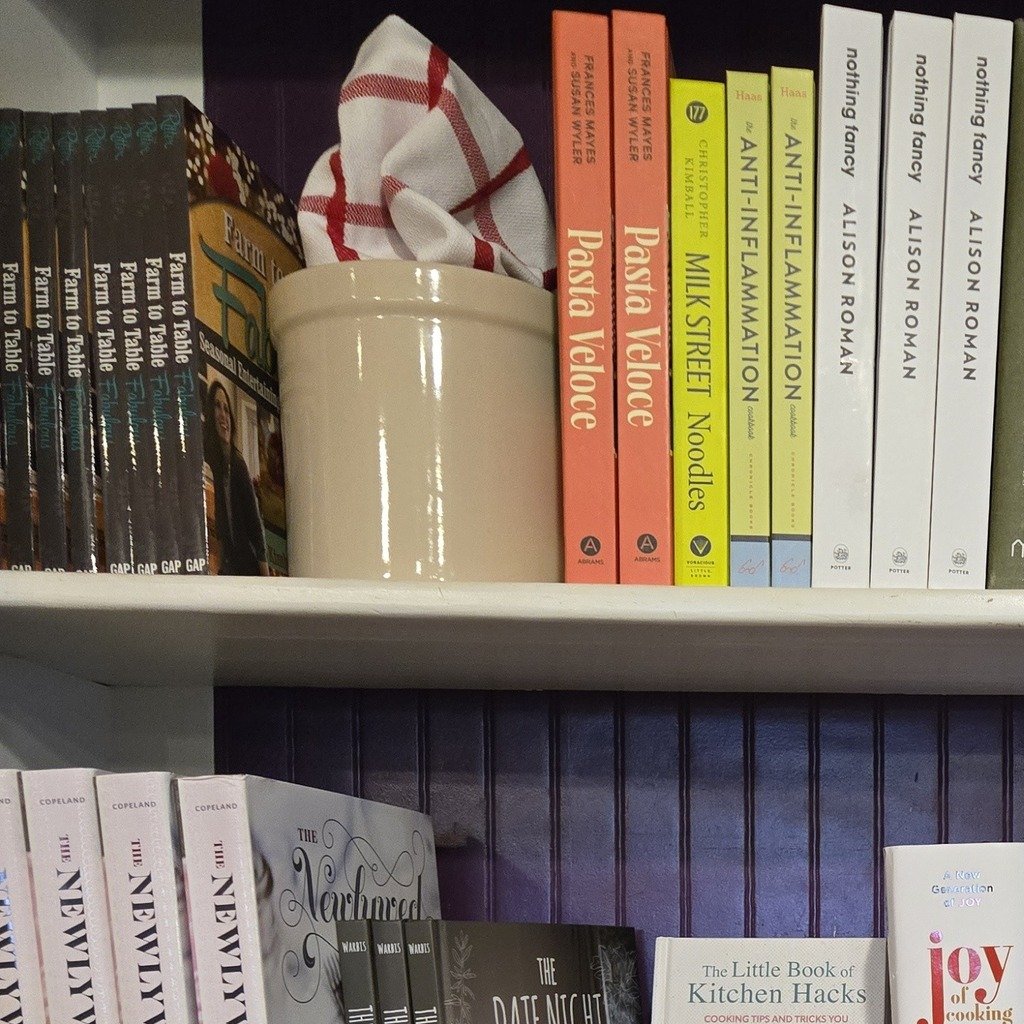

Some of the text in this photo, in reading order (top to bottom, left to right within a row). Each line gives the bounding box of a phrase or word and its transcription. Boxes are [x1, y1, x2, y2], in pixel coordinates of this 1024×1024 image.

[571, 70, 583, 165] SUSAN WYLER
[584, 54, 596, 166] FRANCES MAYES
[735, 89, 763, 102] Haas
[684, 157, 694, 220] KIMBALL
[699, 139, 709, 240] CHRISTOPHER
[839, 47, 861, 376] nothing fancy ALISON ROMAN
[223, 208, 267, 277] Farm
[740, 136, 760, 402] ANTI-INFLAMMATION
[168, 251, 191, 365] Farm to Table
[567, 227, 606, 430] Pasta Veloce
[685, 252, 714, 511] MILK STREET Noodles
[185, 558, 206, 573] GAP
[195, 802, 238, 812] COPELAND
[213, 840, 226, 870] THE
[342, 941, 367, 953] WARBIS
[536, 957, 558, 986] THE
[702, 961, 855, 978] The Little Book of
[687, 982, 867, 1004] Kitchen Hacks
[704, 1015, 849, 1024] COOKING TIPS AND TRICKS YOU
